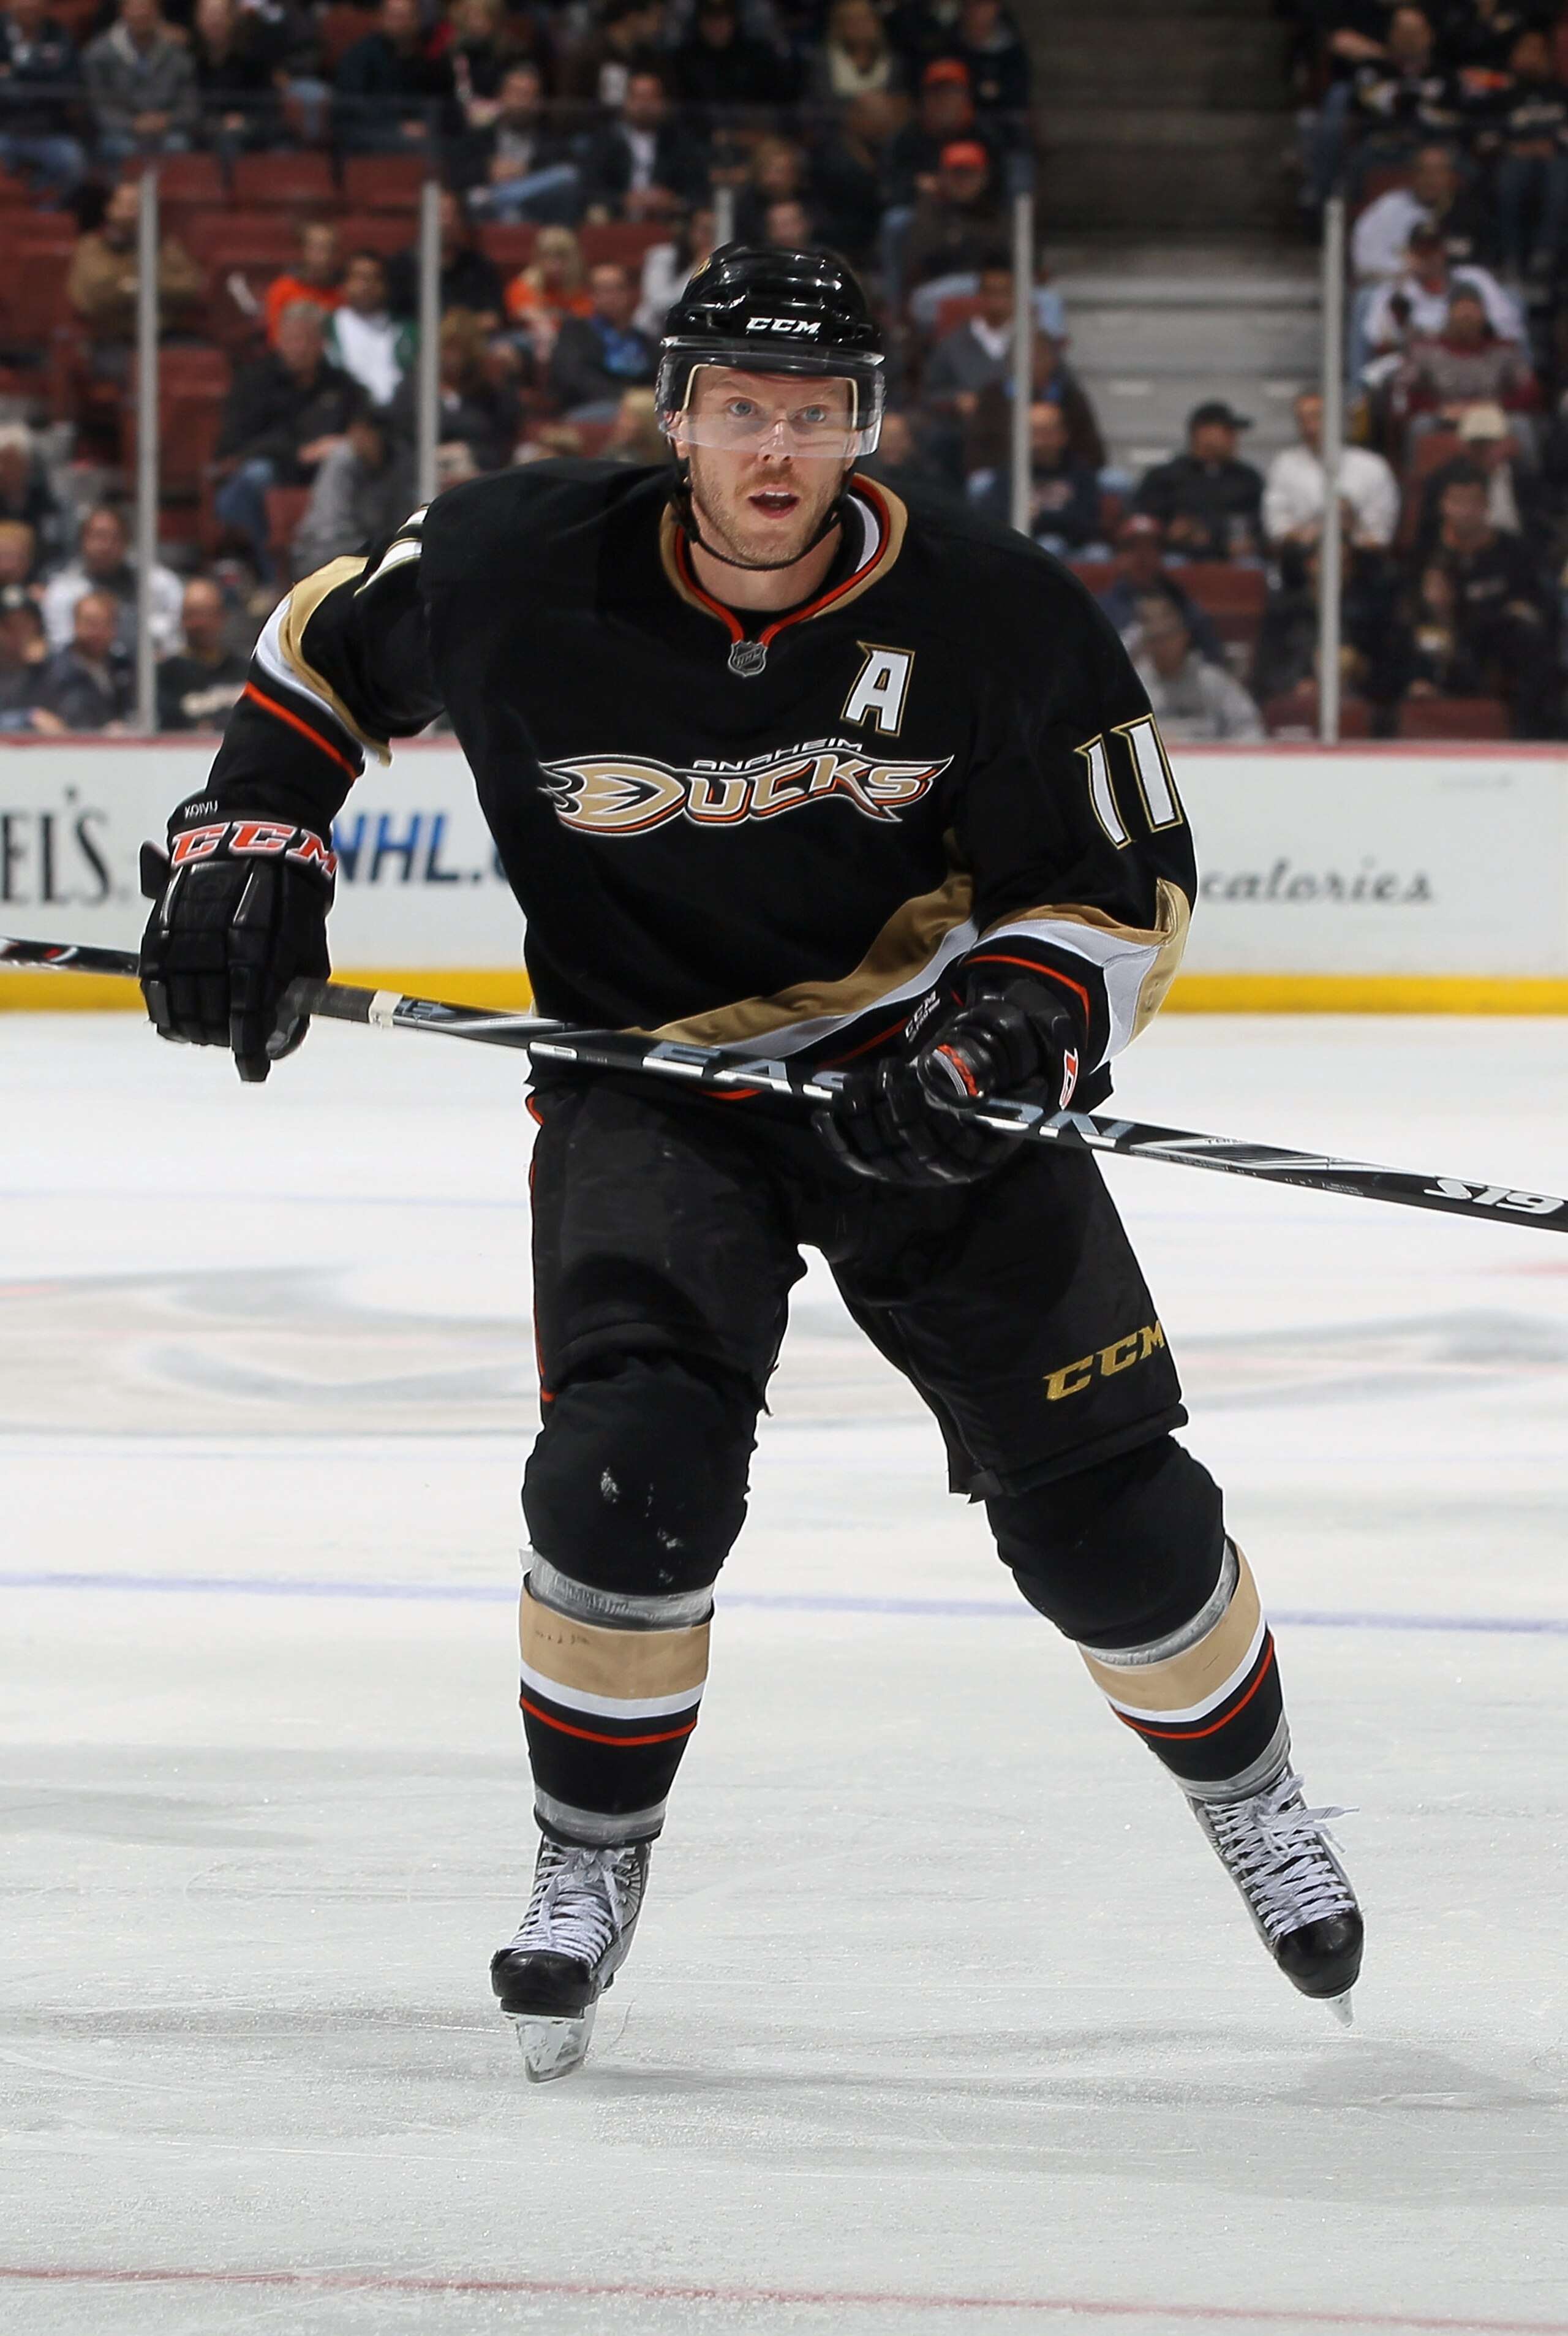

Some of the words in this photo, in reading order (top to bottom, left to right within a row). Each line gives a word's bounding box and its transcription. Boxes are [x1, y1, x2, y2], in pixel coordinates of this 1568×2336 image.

[746, 317, 821, 335] CCM
[840, 641, 915, 737] A
[693, 738, 862, 771] ANAHEIM
[538, 754, 954, 836] DUCKS
[1075, 713, 1183, 850] 11
[185, 800, 218, 819] KOIVU
[171, 820, 338, 880] CCM
[1200, 856, 1433, 902] calories
[905, 990, 936, 1038] CCM
[1423, 1179, 1564, 1214] S19
[1042, 1320, 1164, 1401] CCM
